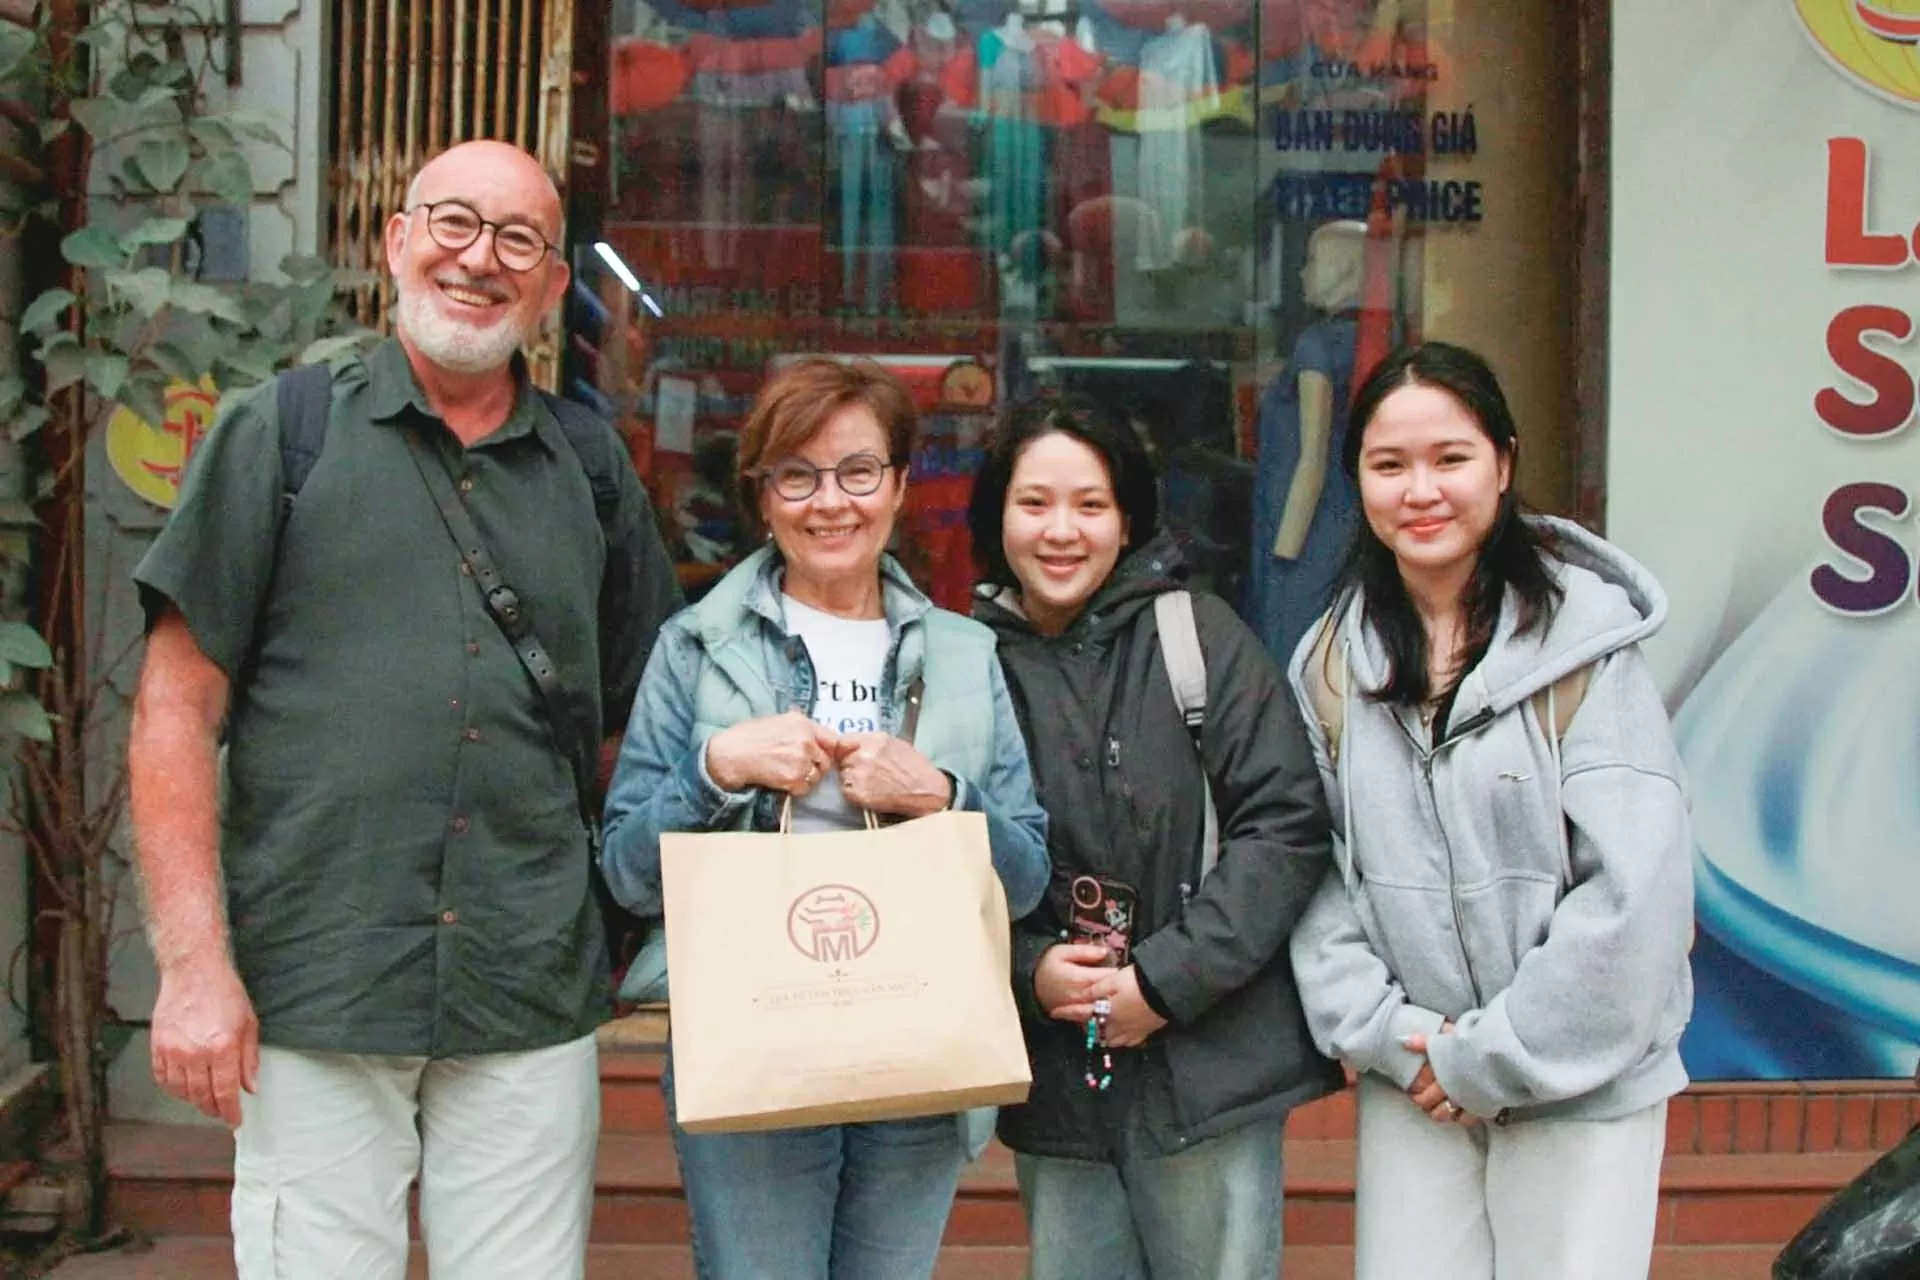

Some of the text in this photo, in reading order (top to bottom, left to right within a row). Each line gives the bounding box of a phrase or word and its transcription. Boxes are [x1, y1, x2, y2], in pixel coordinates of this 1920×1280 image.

[1432, 104, 1477, 154] GIÁ
[1386, 179, 1482, 221] PRICE
[1814, 304, 1920, 436] S
[1810, 481, 1920, 613] S
